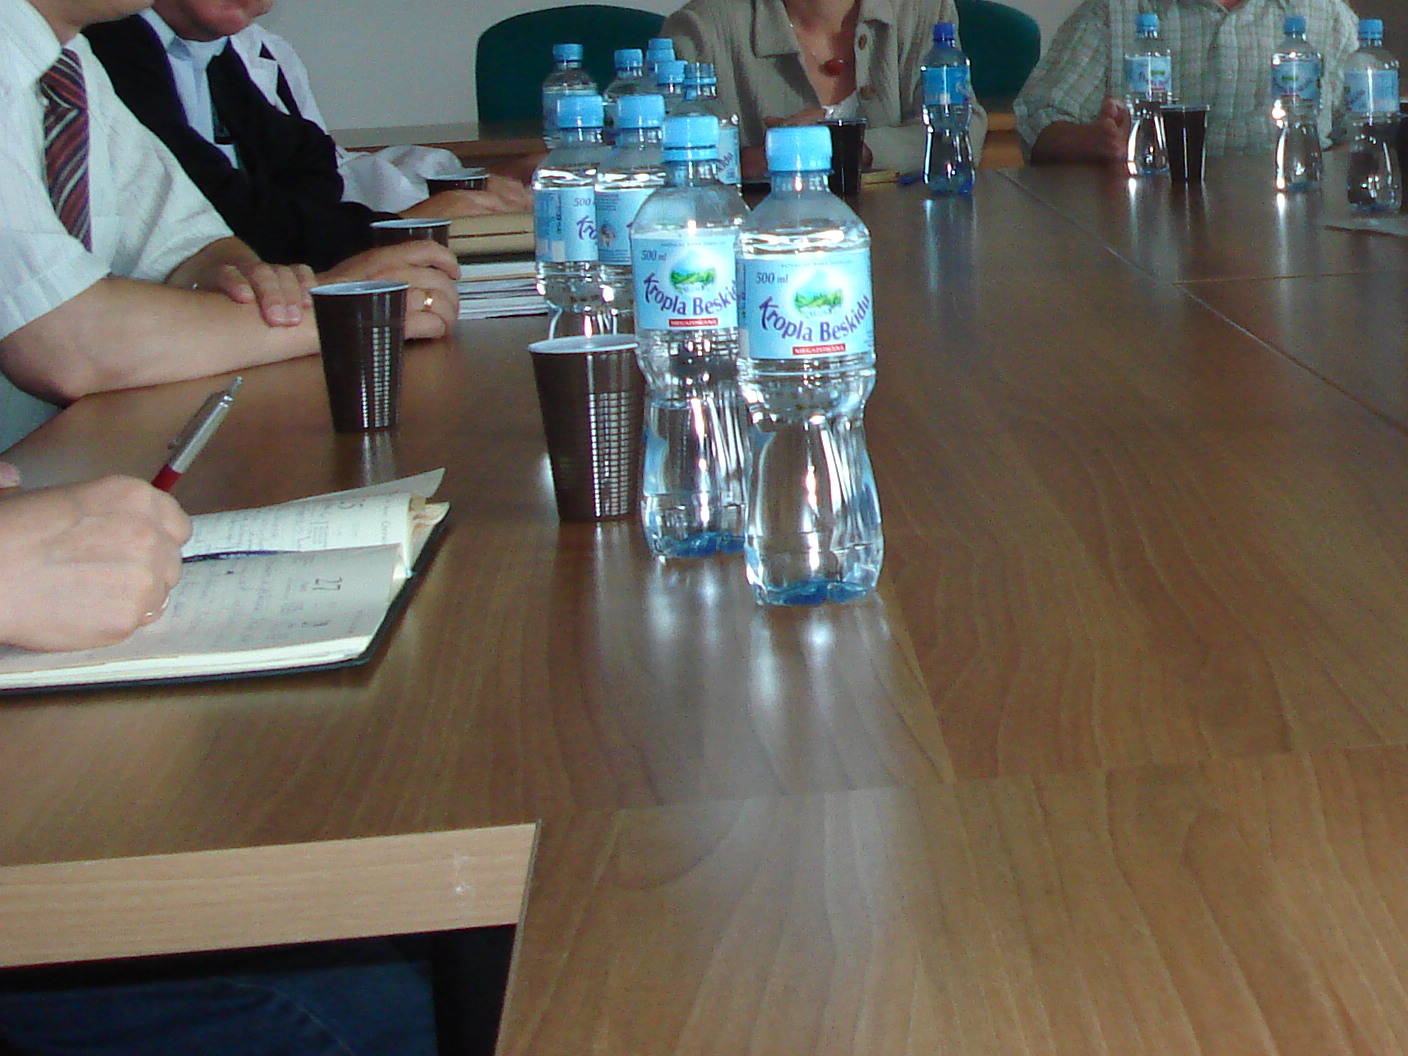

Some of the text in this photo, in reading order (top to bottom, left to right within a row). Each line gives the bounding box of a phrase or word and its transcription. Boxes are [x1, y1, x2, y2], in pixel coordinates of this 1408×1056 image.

[573, 197, 592, 207] 500
[640, 250, 657, 262] 500
[756, 272, 789, 284] 500 ml
[643, 272, 687, 316] Kropla
[692, 279, 737, 316] Beskid
[758, 293, 870, 342] Kropla Beskidu
